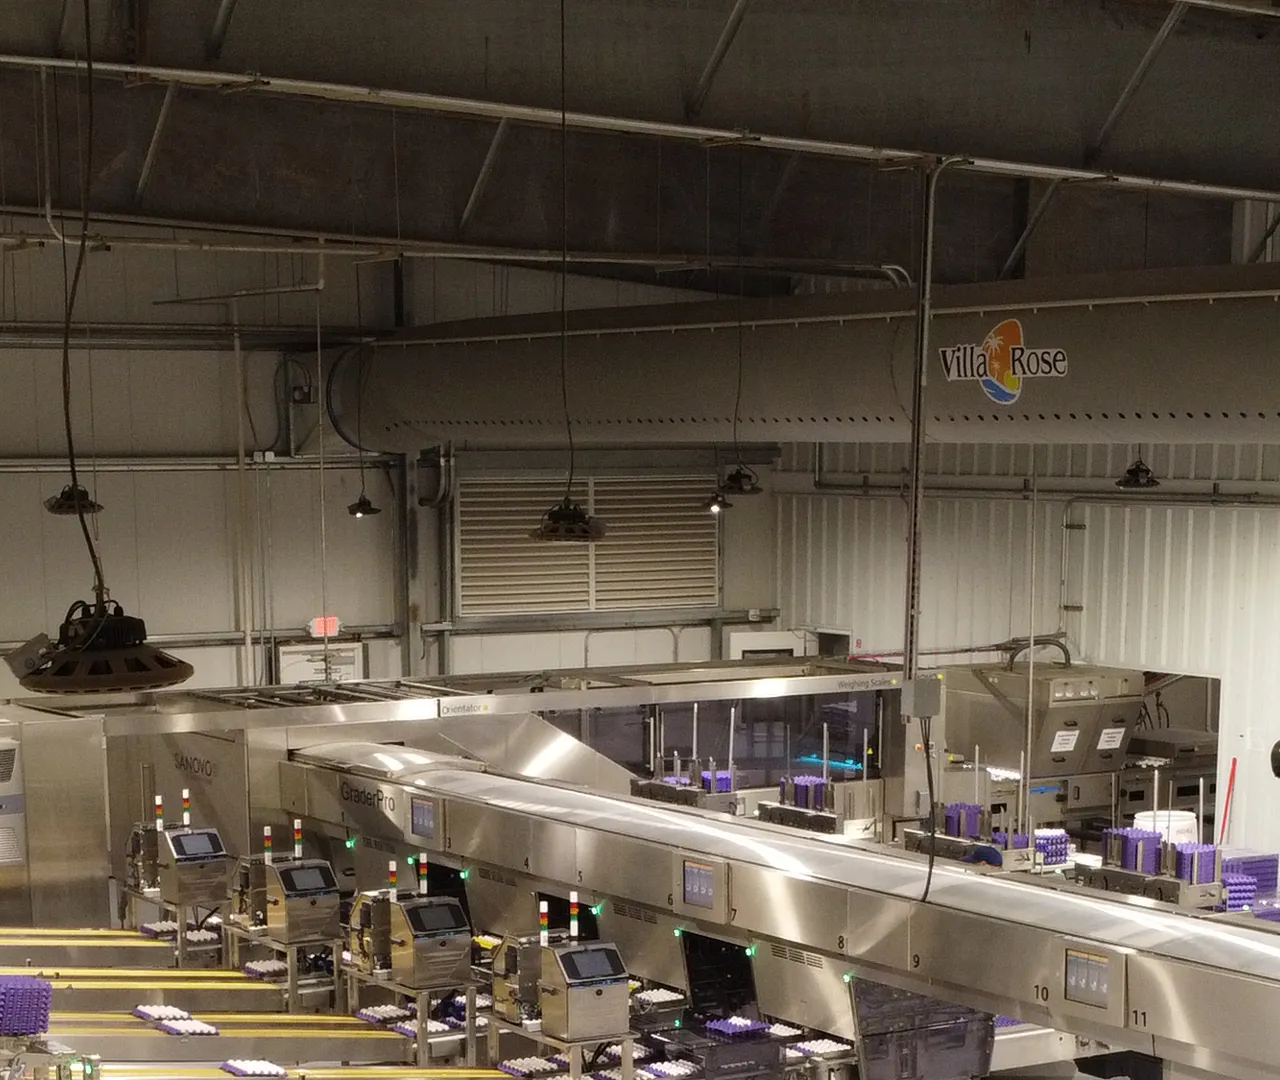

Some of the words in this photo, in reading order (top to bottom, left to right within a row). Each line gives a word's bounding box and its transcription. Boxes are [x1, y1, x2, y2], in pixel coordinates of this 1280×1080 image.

[940, 345, 989, 379] Villa
[1010, 346, 1067, 376] Rose
[441, 703, 482, 715] Orientator
[174, 753, 213, 778] SANOVO
[340, 781, 396, 812] GraderPro
[523, 856, 530, 870] 4
[577, 870, 583, 883] 5
[667, 893, 674, 906] 6
[731, 907, 738, 921] 7
[837, 935, 845, 950] 8
[912, 953, 920, 968] 9
[1033, 984, 1049, 1002] 10
[1132, 1009, 1147, 1027] 11
